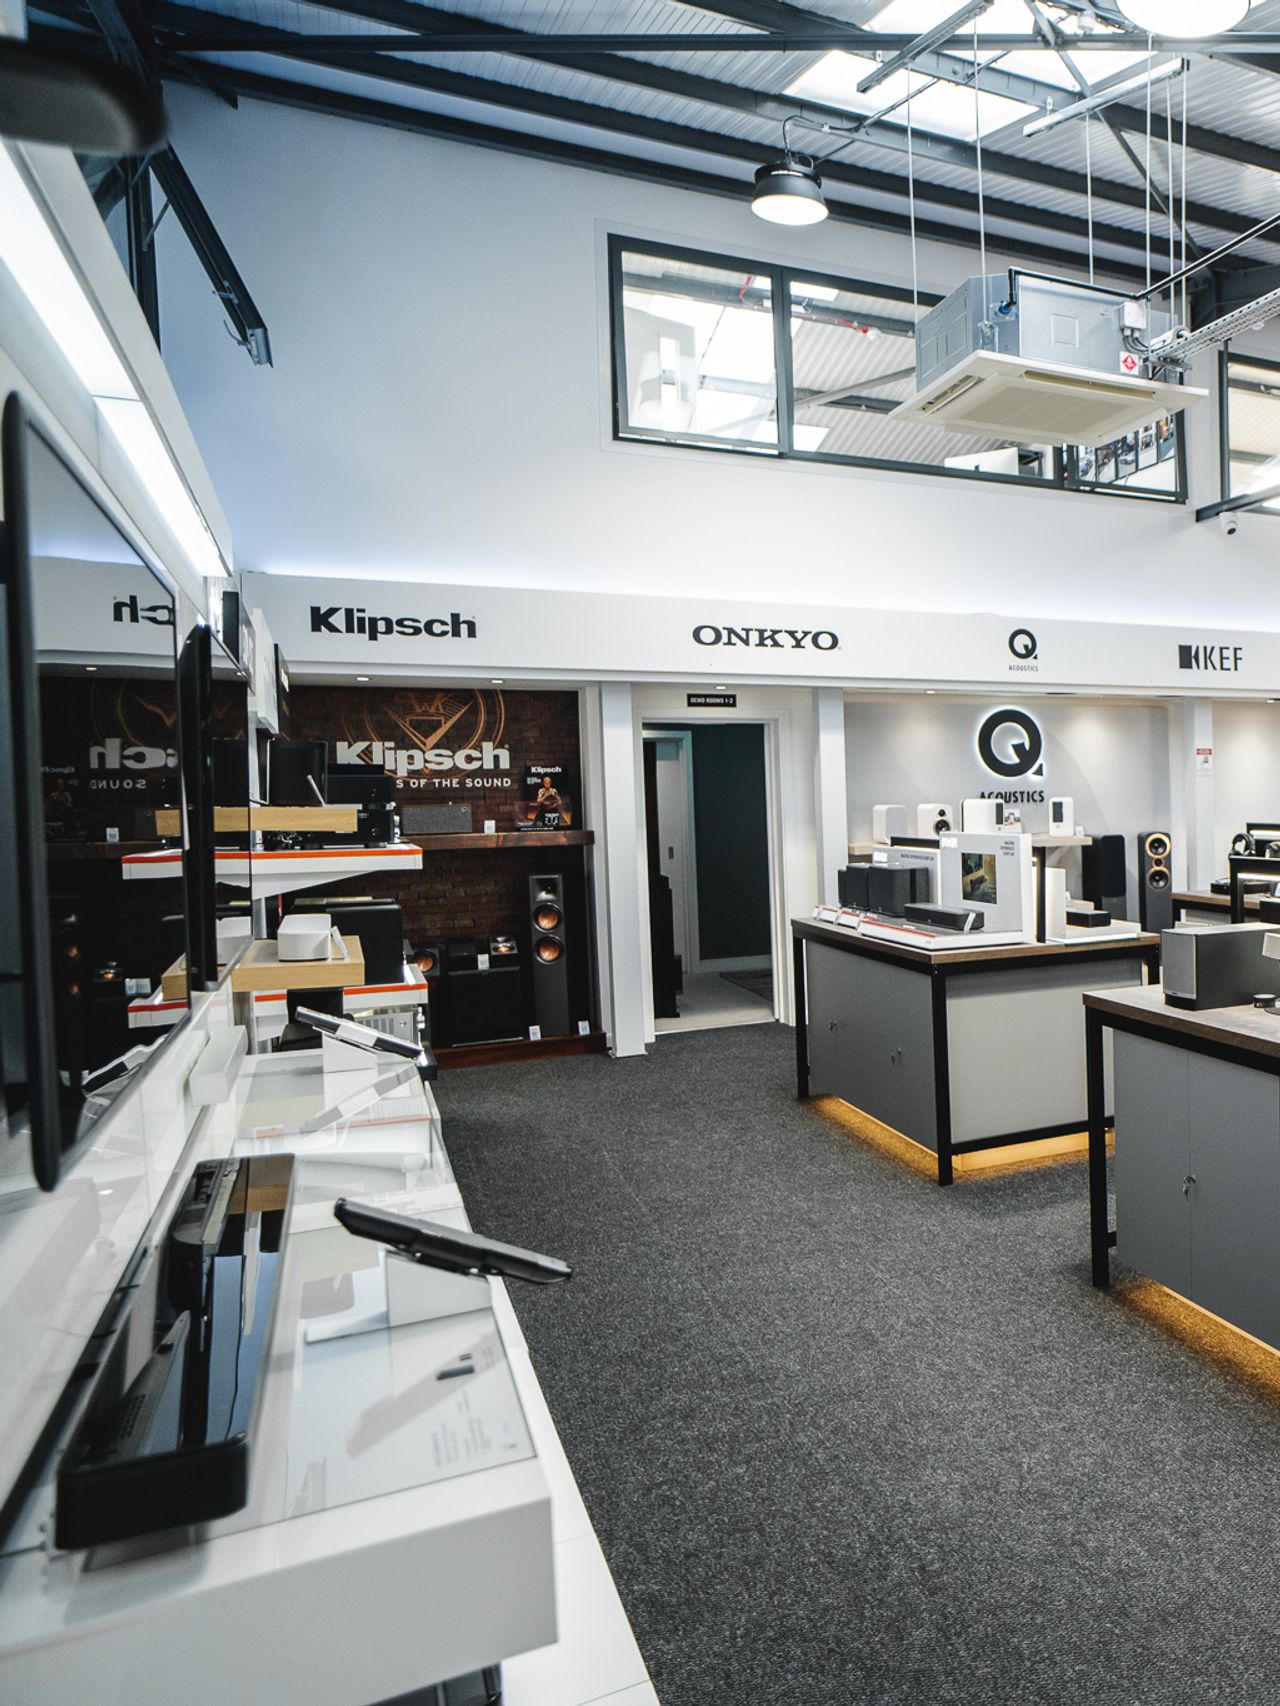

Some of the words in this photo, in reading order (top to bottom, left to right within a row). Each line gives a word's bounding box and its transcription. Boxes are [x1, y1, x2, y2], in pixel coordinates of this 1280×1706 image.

[310, 606, 477, 641] Klipsch
[692, 625, 839, 651] ONKYO
[1008, 628, 1038, 660] Q
[1008, 664, 1039, 672] ACOUSTICS
[1203, 645, 1243, 671] KEF
[978, 708, 1044, 778] Q
[336, 741, 510, 777] Klipsch
[531, 766, 562, 774] Klipsch
[410, 778, 428, 788] OF
[432, 778, 460, 788] THE
[465, 777, 512, 788] SOUND
[979, 790, 1045, 803] ACOUSTICS
